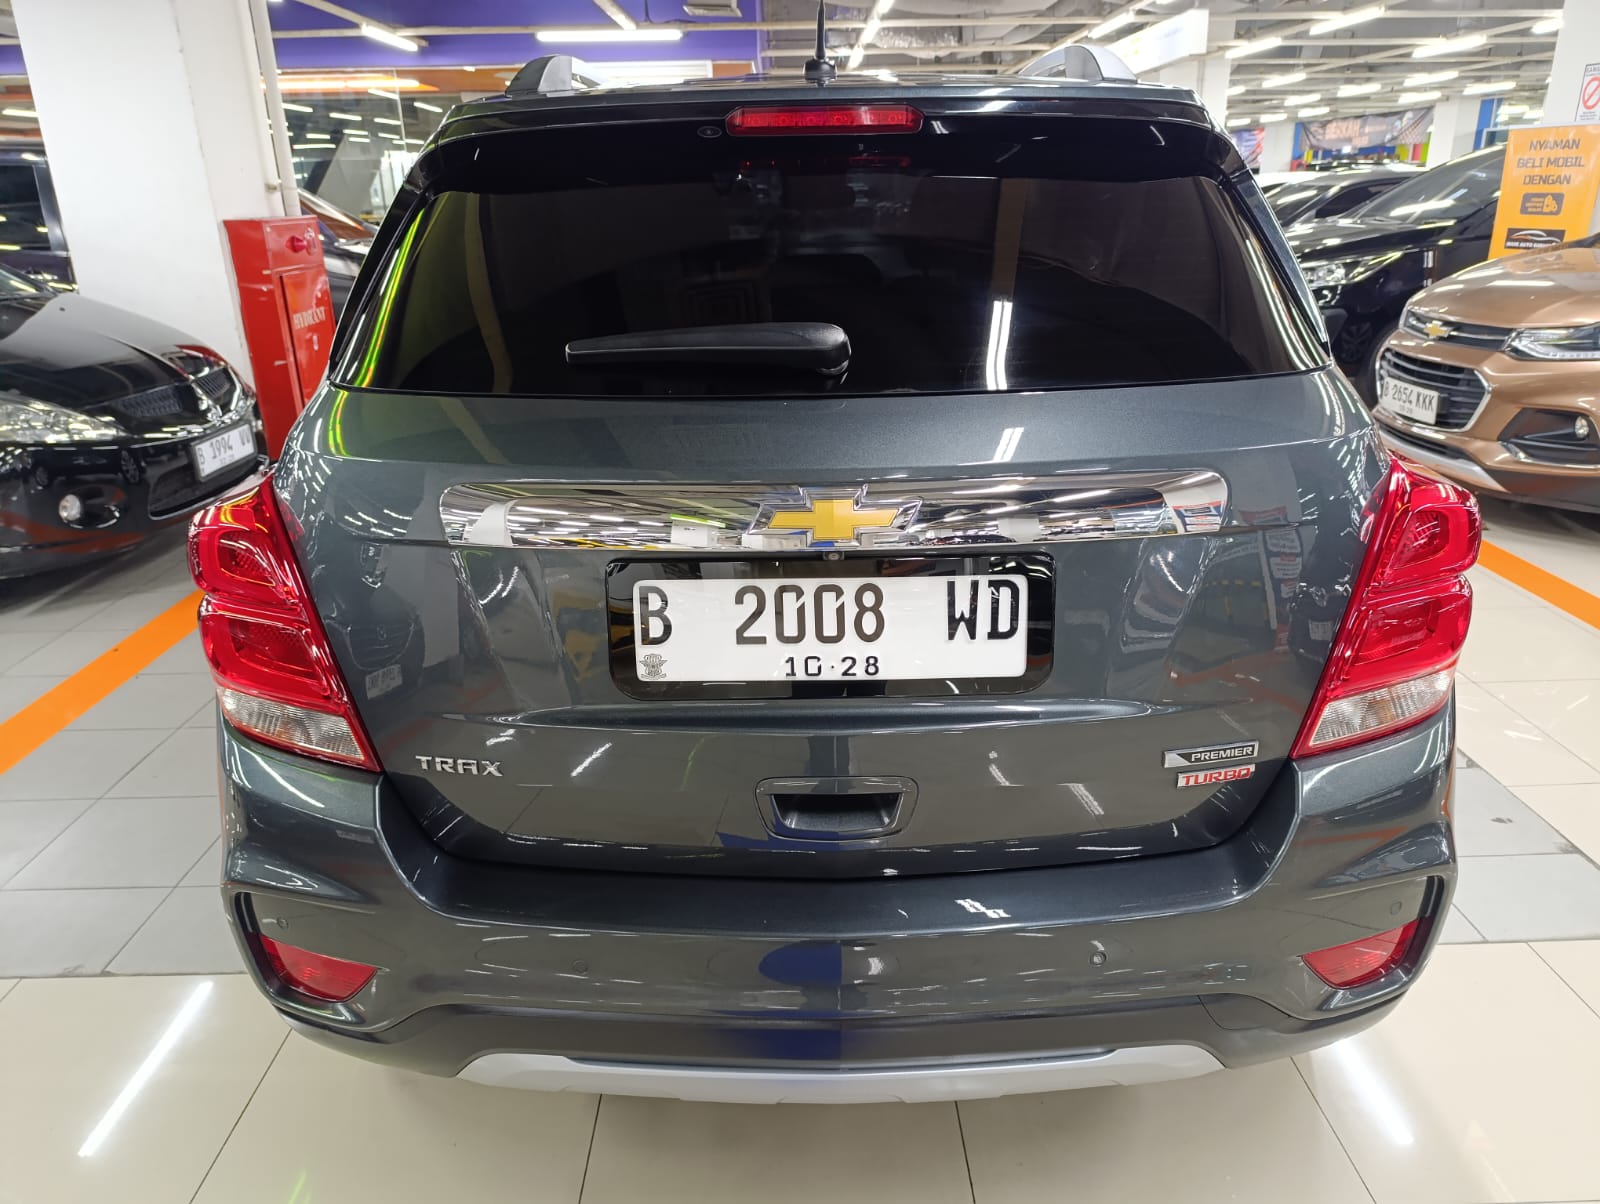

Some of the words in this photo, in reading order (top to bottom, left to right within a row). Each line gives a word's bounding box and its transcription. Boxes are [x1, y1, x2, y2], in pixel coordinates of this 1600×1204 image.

[1529, 139, 1580, 151] NYAMAN
[1516, 157, 1544, 169] BELI
[1546, 156, 1585, 168] MOBIL
[1522, 173, 1572, 186] DENGAN
[293, 306, 326, 330] HYDRANT
[197, 447, 206, 465] B
[639, 586, 672, 646] B
[735, 583, 885, 645] 2008
[947, 580, 1020, 640] WD
[1191, 746, 1253, 761] PREMIER
[415, 755, 503, 777] TRAX
[1182, 767, 1251, 785] TURBO
